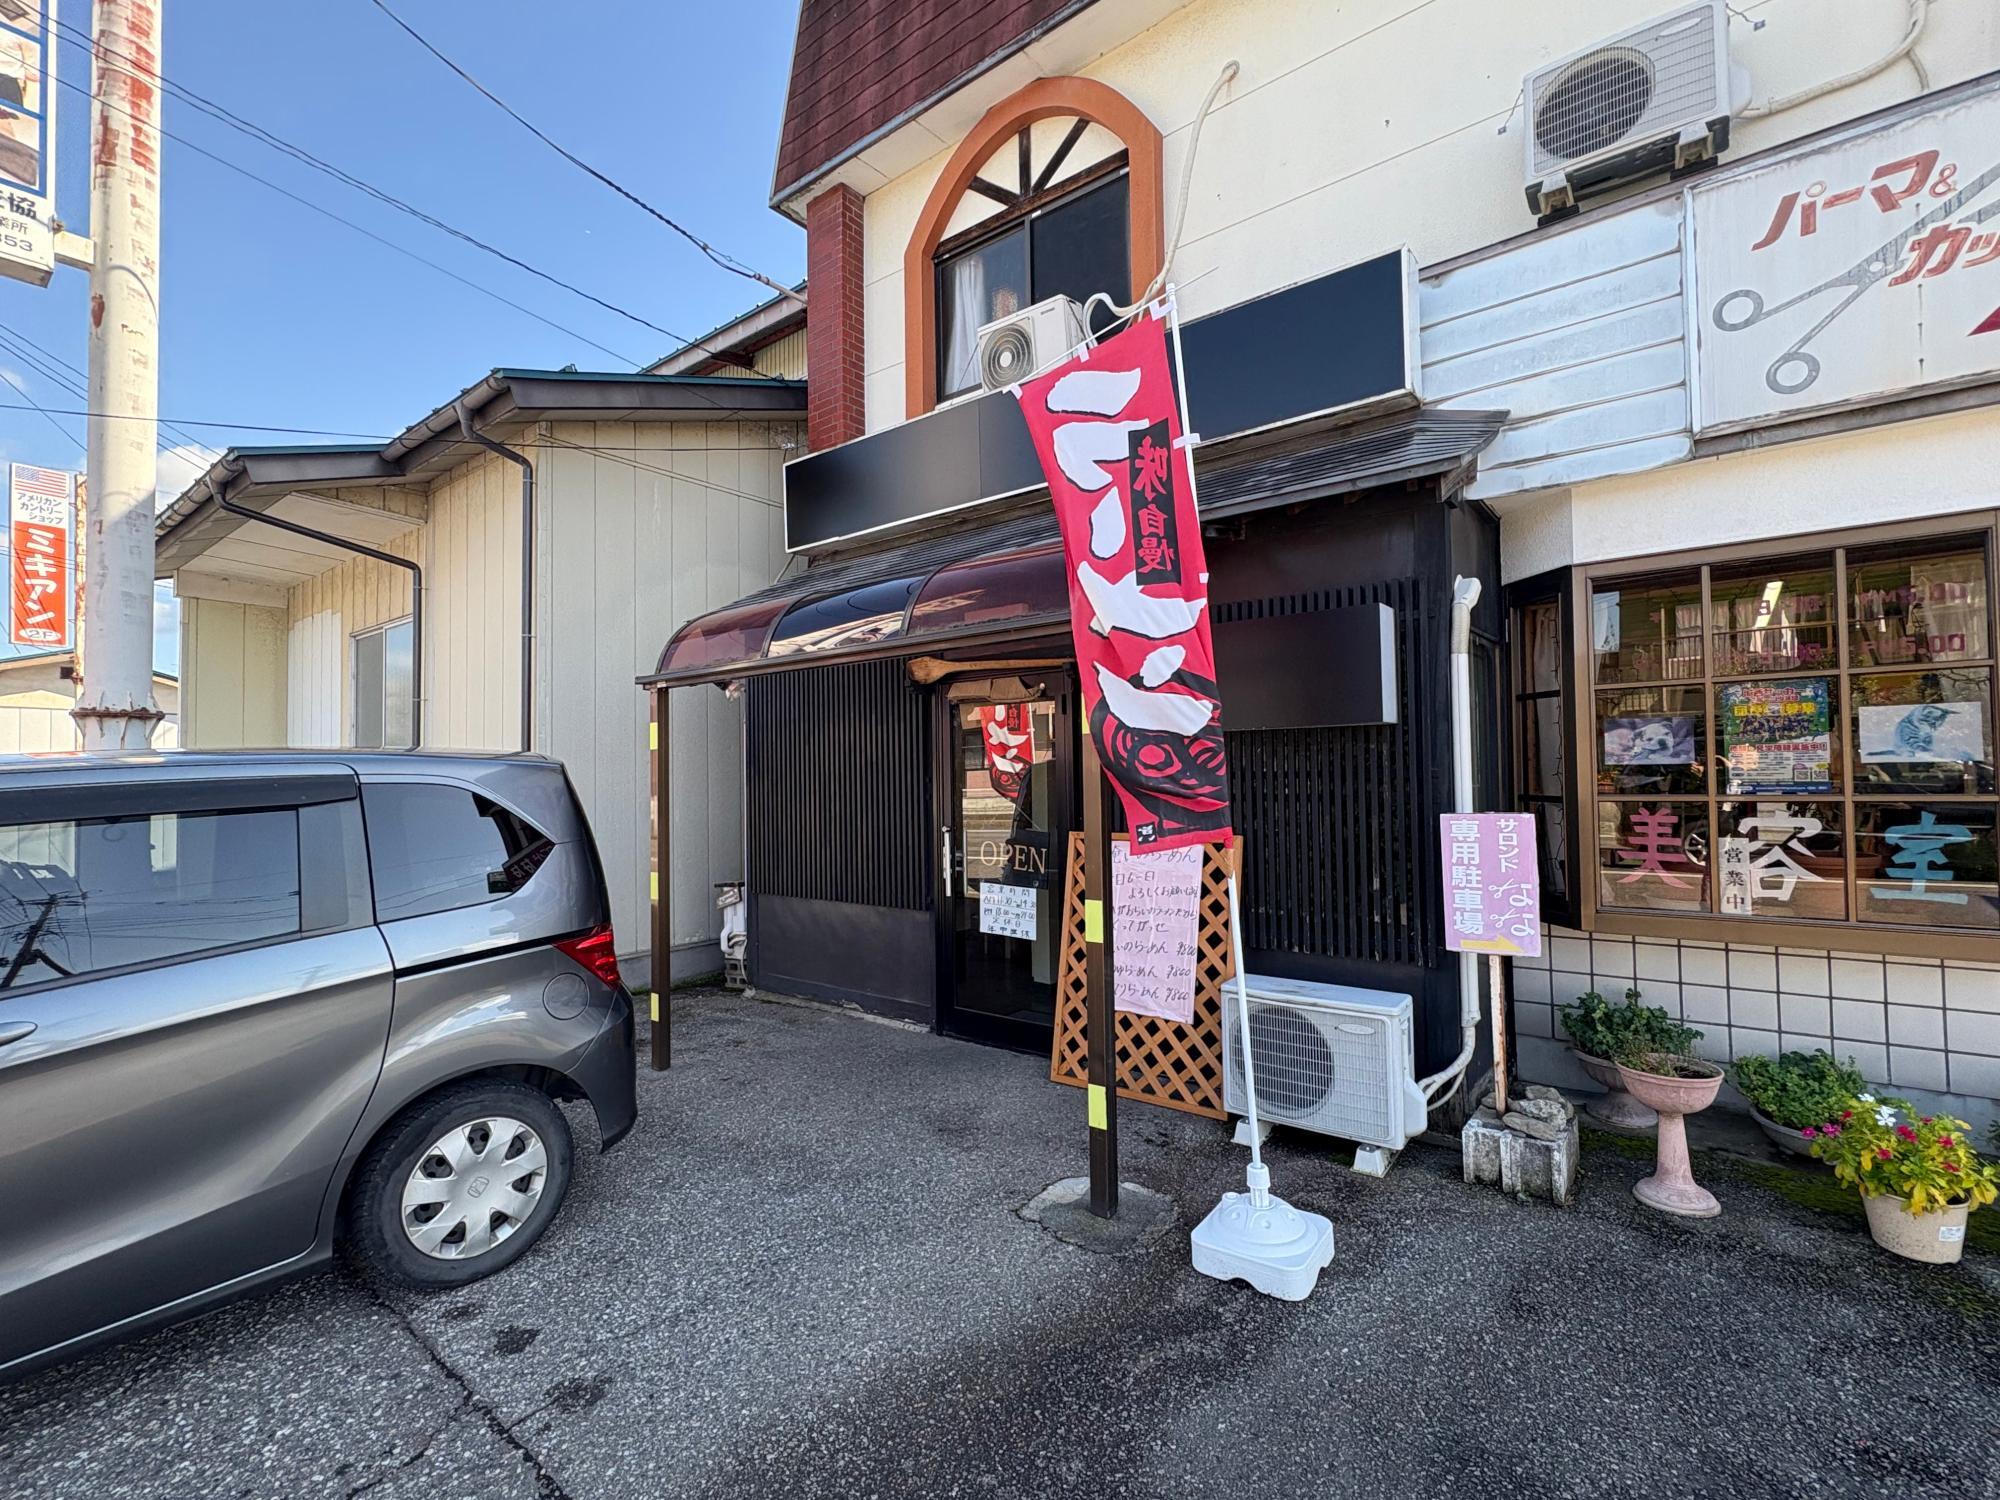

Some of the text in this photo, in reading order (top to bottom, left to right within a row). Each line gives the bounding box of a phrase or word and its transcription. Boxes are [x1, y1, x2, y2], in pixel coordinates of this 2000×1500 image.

[0, 190, 36, 219] 協
[0, 234, 33, 252] 53
[17, 492, 62, 507] アメリカン
[20, 502, 63, 515] カントリー
[29, 512, 65, 524] ショップ
[24, 527, 57, 625] ミキアン
[981, 841, 1047, 874] OPEN
[1450, 819, 1484, 935] 専用駐車場
[1724, 847, 1745, 909] 営業中
